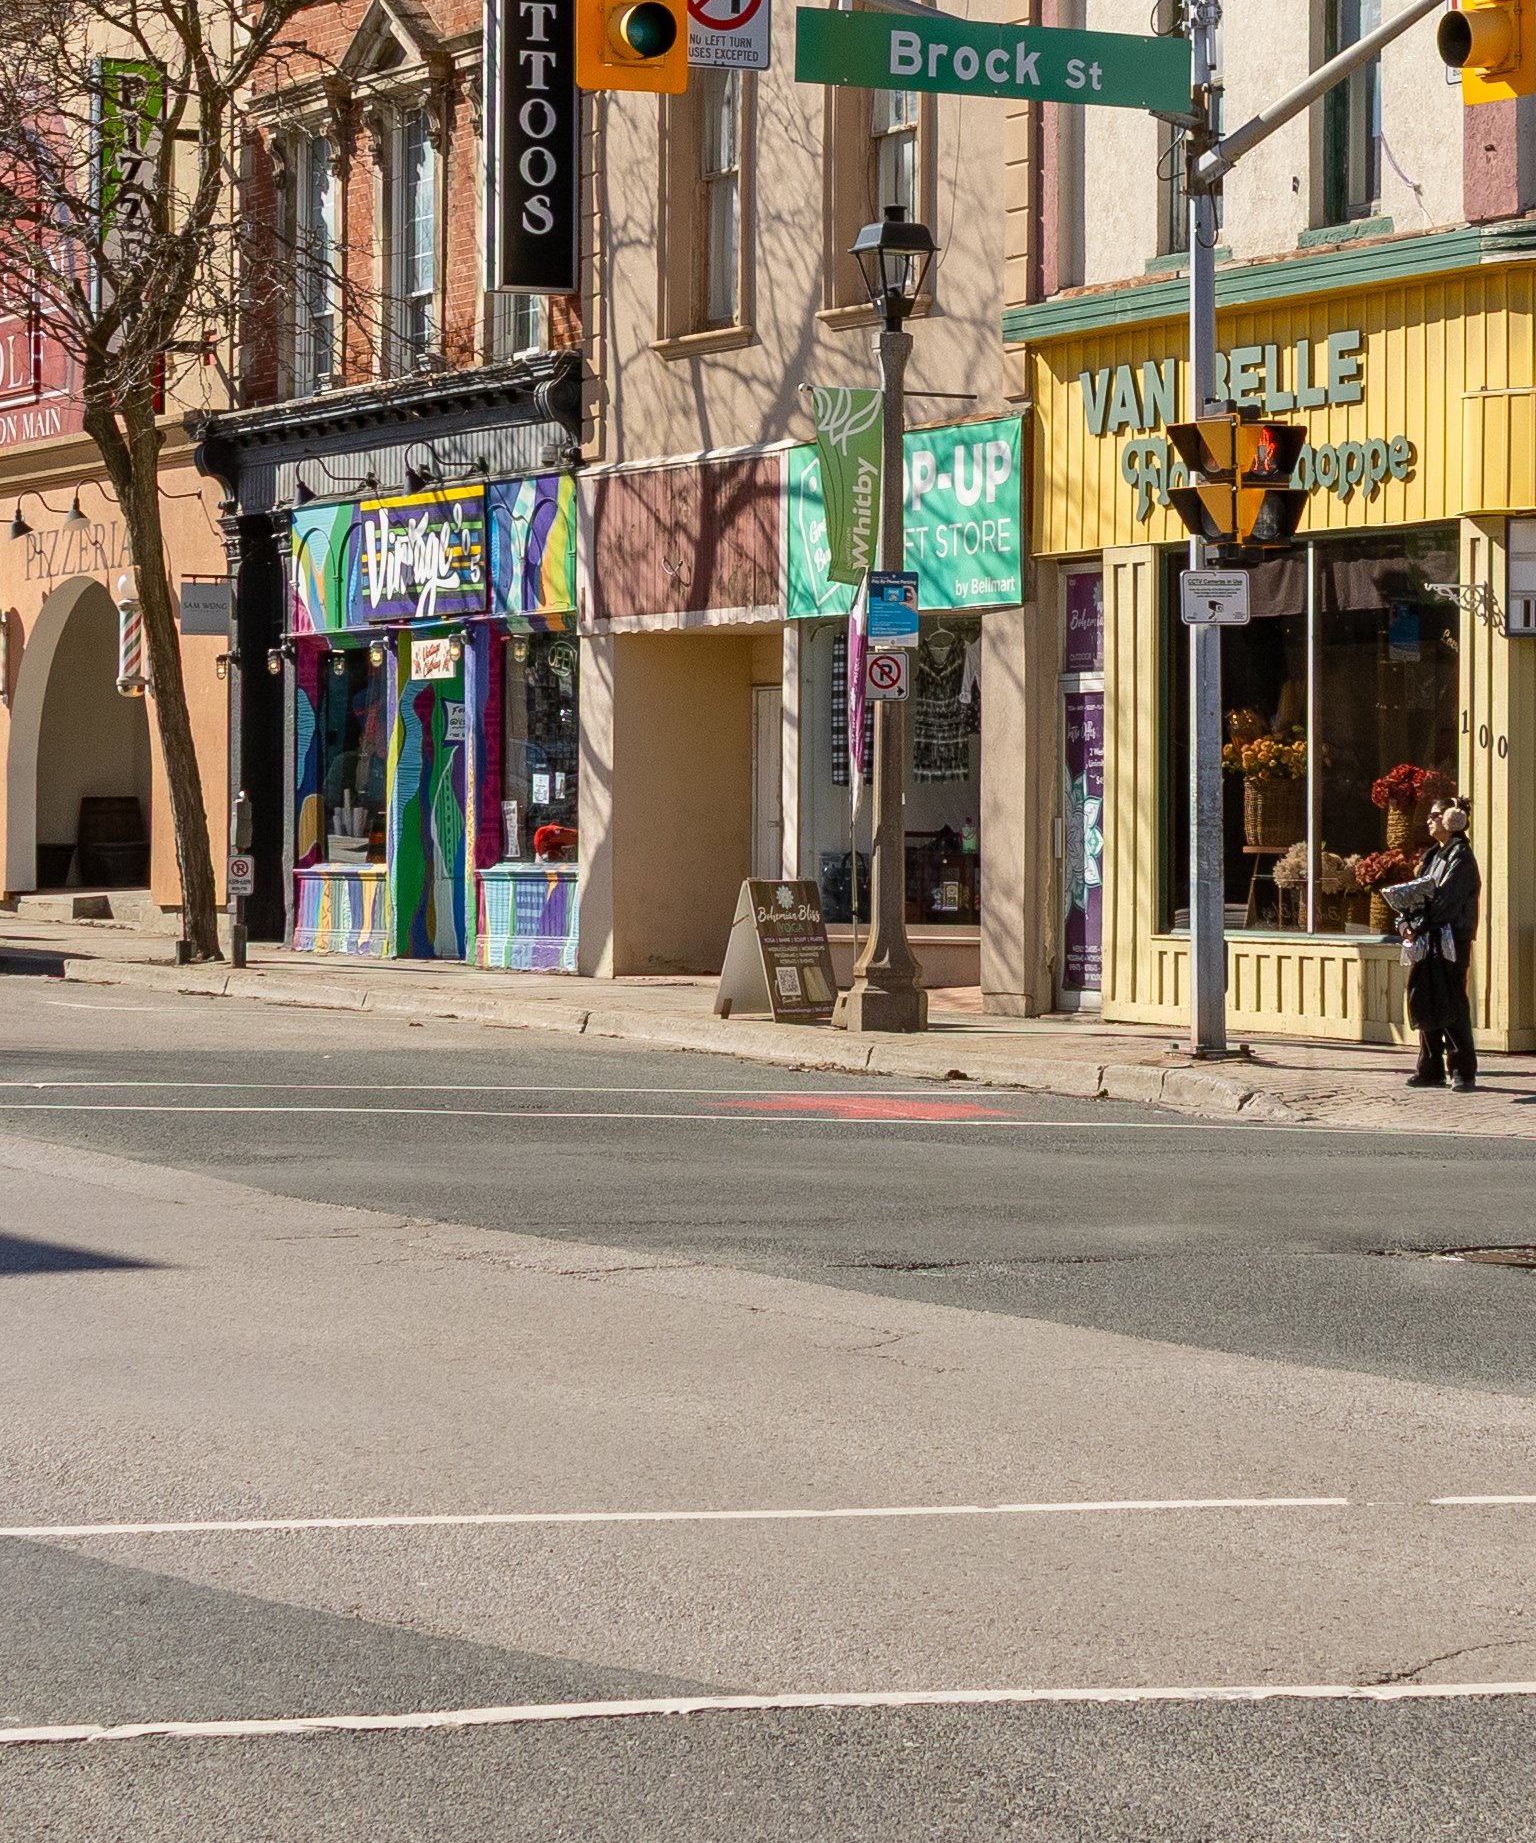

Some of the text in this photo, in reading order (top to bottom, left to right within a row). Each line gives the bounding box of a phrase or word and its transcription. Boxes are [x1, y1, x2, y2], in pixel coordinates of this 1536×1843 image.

[688, 47, 759, 62] USES EXCEPTED
[689, 34, 752, 48] NO LEFT TURN
[889, 29, 1103, 91] Brock St
[1080, 358, 1175, 436] VAN
[22, 406, 62, 441] MAIN
[904, 440, 1012, 511] P-UP
[1122, 435, 1410, 523] Flo hoppe
[852, 457, 879, 570] Whitby
[903, 518, 1011, 560] FT STORE
[956, 576, 1015, 598] by Bellmart
[548, 645, 577, 673] OPEN
[1462, 709, 1508, 759] 100
[757, 904, 820, 923] Bohemian Bliss
[778, 923, 804, 933] YOGA
